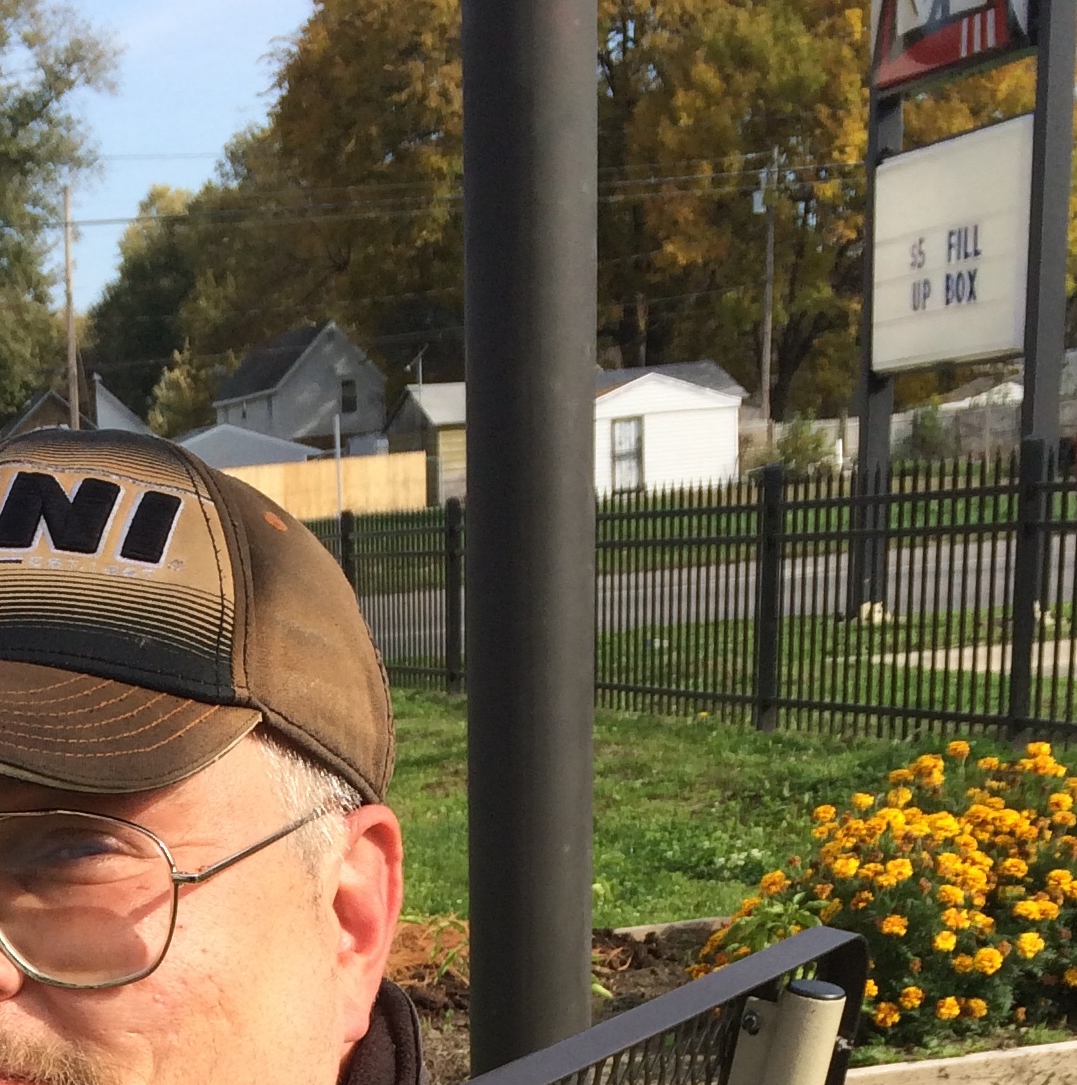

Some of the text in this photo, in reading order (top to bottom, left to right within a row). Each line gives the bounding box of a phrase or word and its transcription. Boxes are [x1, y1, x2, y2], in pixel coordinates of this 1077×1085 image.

[947, 224, 982, 262] FILL
[912, 268, 978, 311] UP BOX
